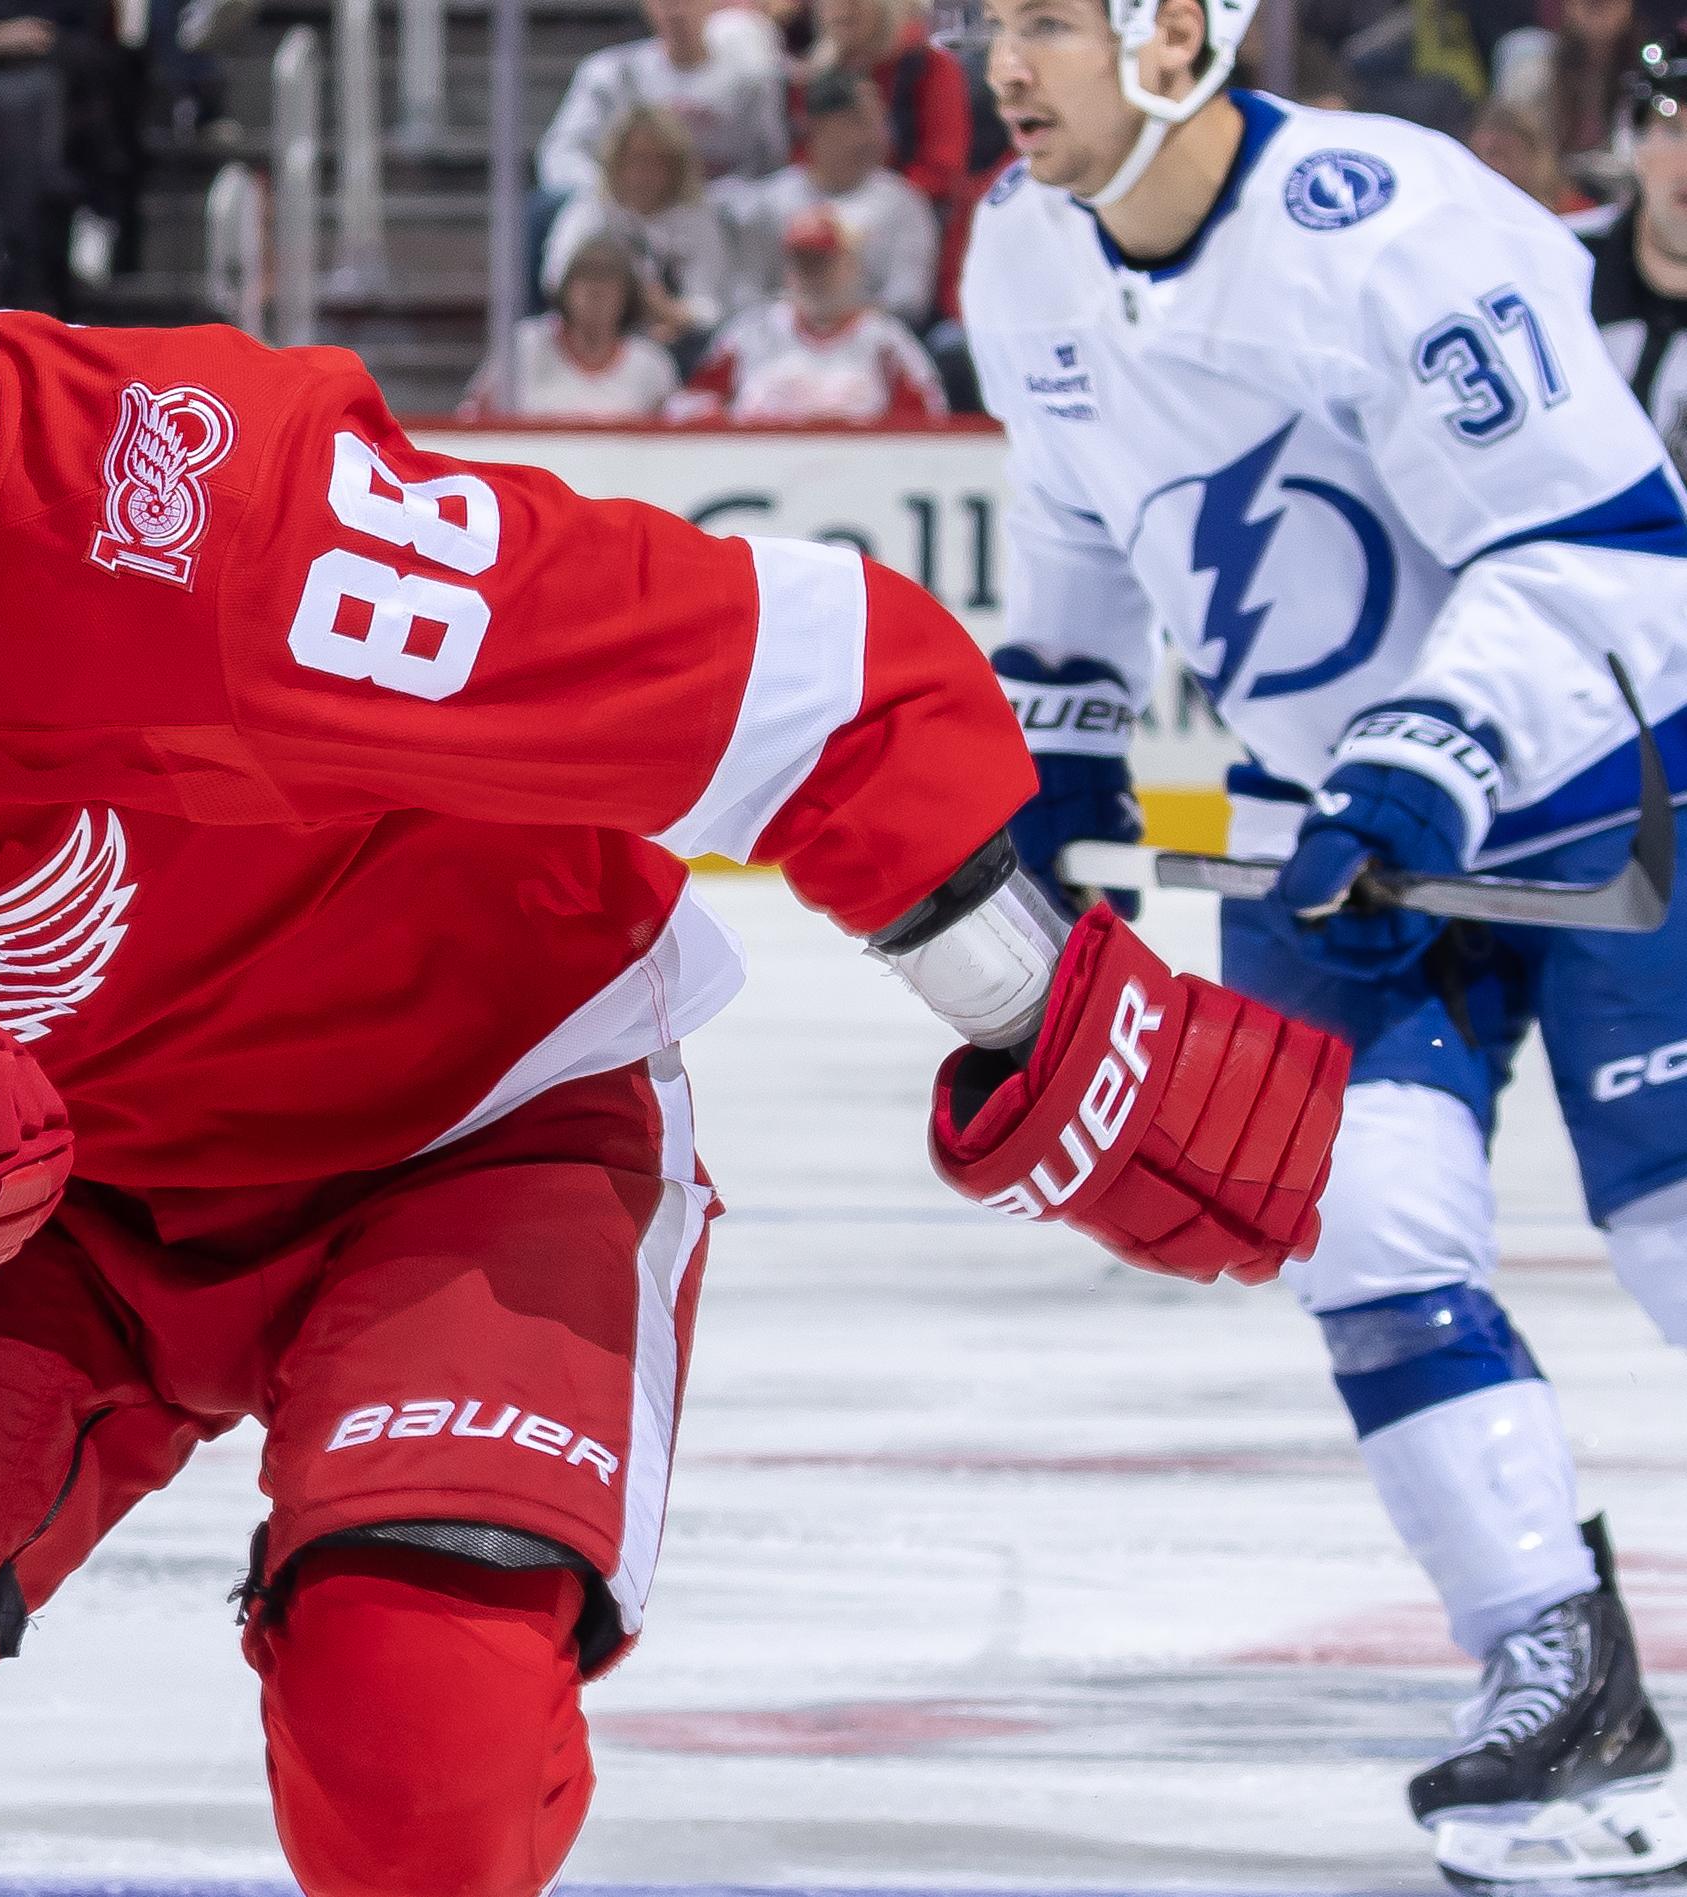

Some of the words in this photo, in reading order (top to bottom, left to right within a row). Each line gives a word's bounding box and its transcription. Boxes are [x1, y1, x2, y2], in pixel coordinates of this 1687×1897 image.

[1413, 282, 1571, 448] 37
[287, 430, 501, 702] 88
[980, 979, 1162, 1219] AUER
[1592, 1038, 1687, 1102] CC
